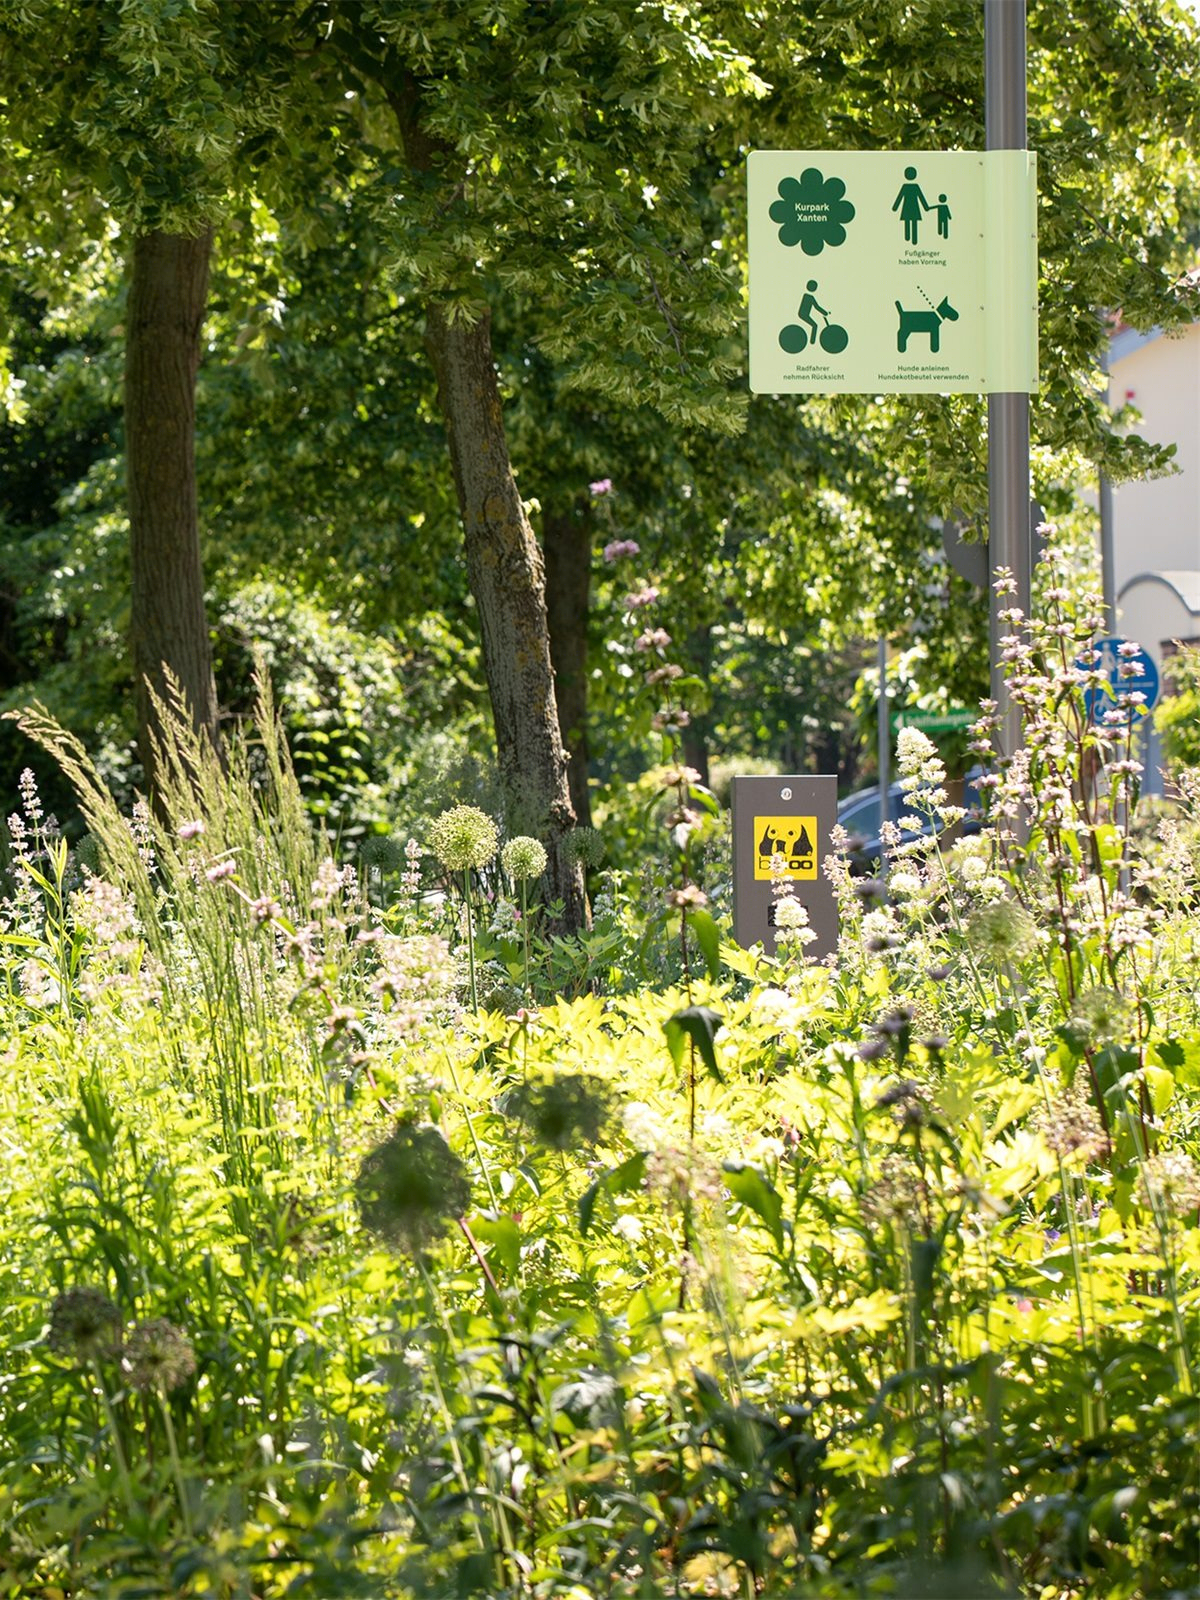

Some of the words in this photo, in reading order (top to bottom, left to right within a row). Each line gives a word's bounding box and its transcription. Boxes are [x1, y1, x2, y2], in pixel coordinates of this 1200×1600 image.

[795, 202, 830, 213] Kurpark
[797, 213, 828, 222] Xanten
[904, 250, 940, 258] Fußgänger
[898, 258, 919, 266] haben
[920, 258, 947, 267] Vorrang
[795, 364, 830, 372] Radfahrer
[783, 373, 810, 381] nehmen
[811, 373, 845, 381] Rücksicht
[878, 373, 932, 381] Hundekotbeutel
[932, 373, 970, 381] verwenden
